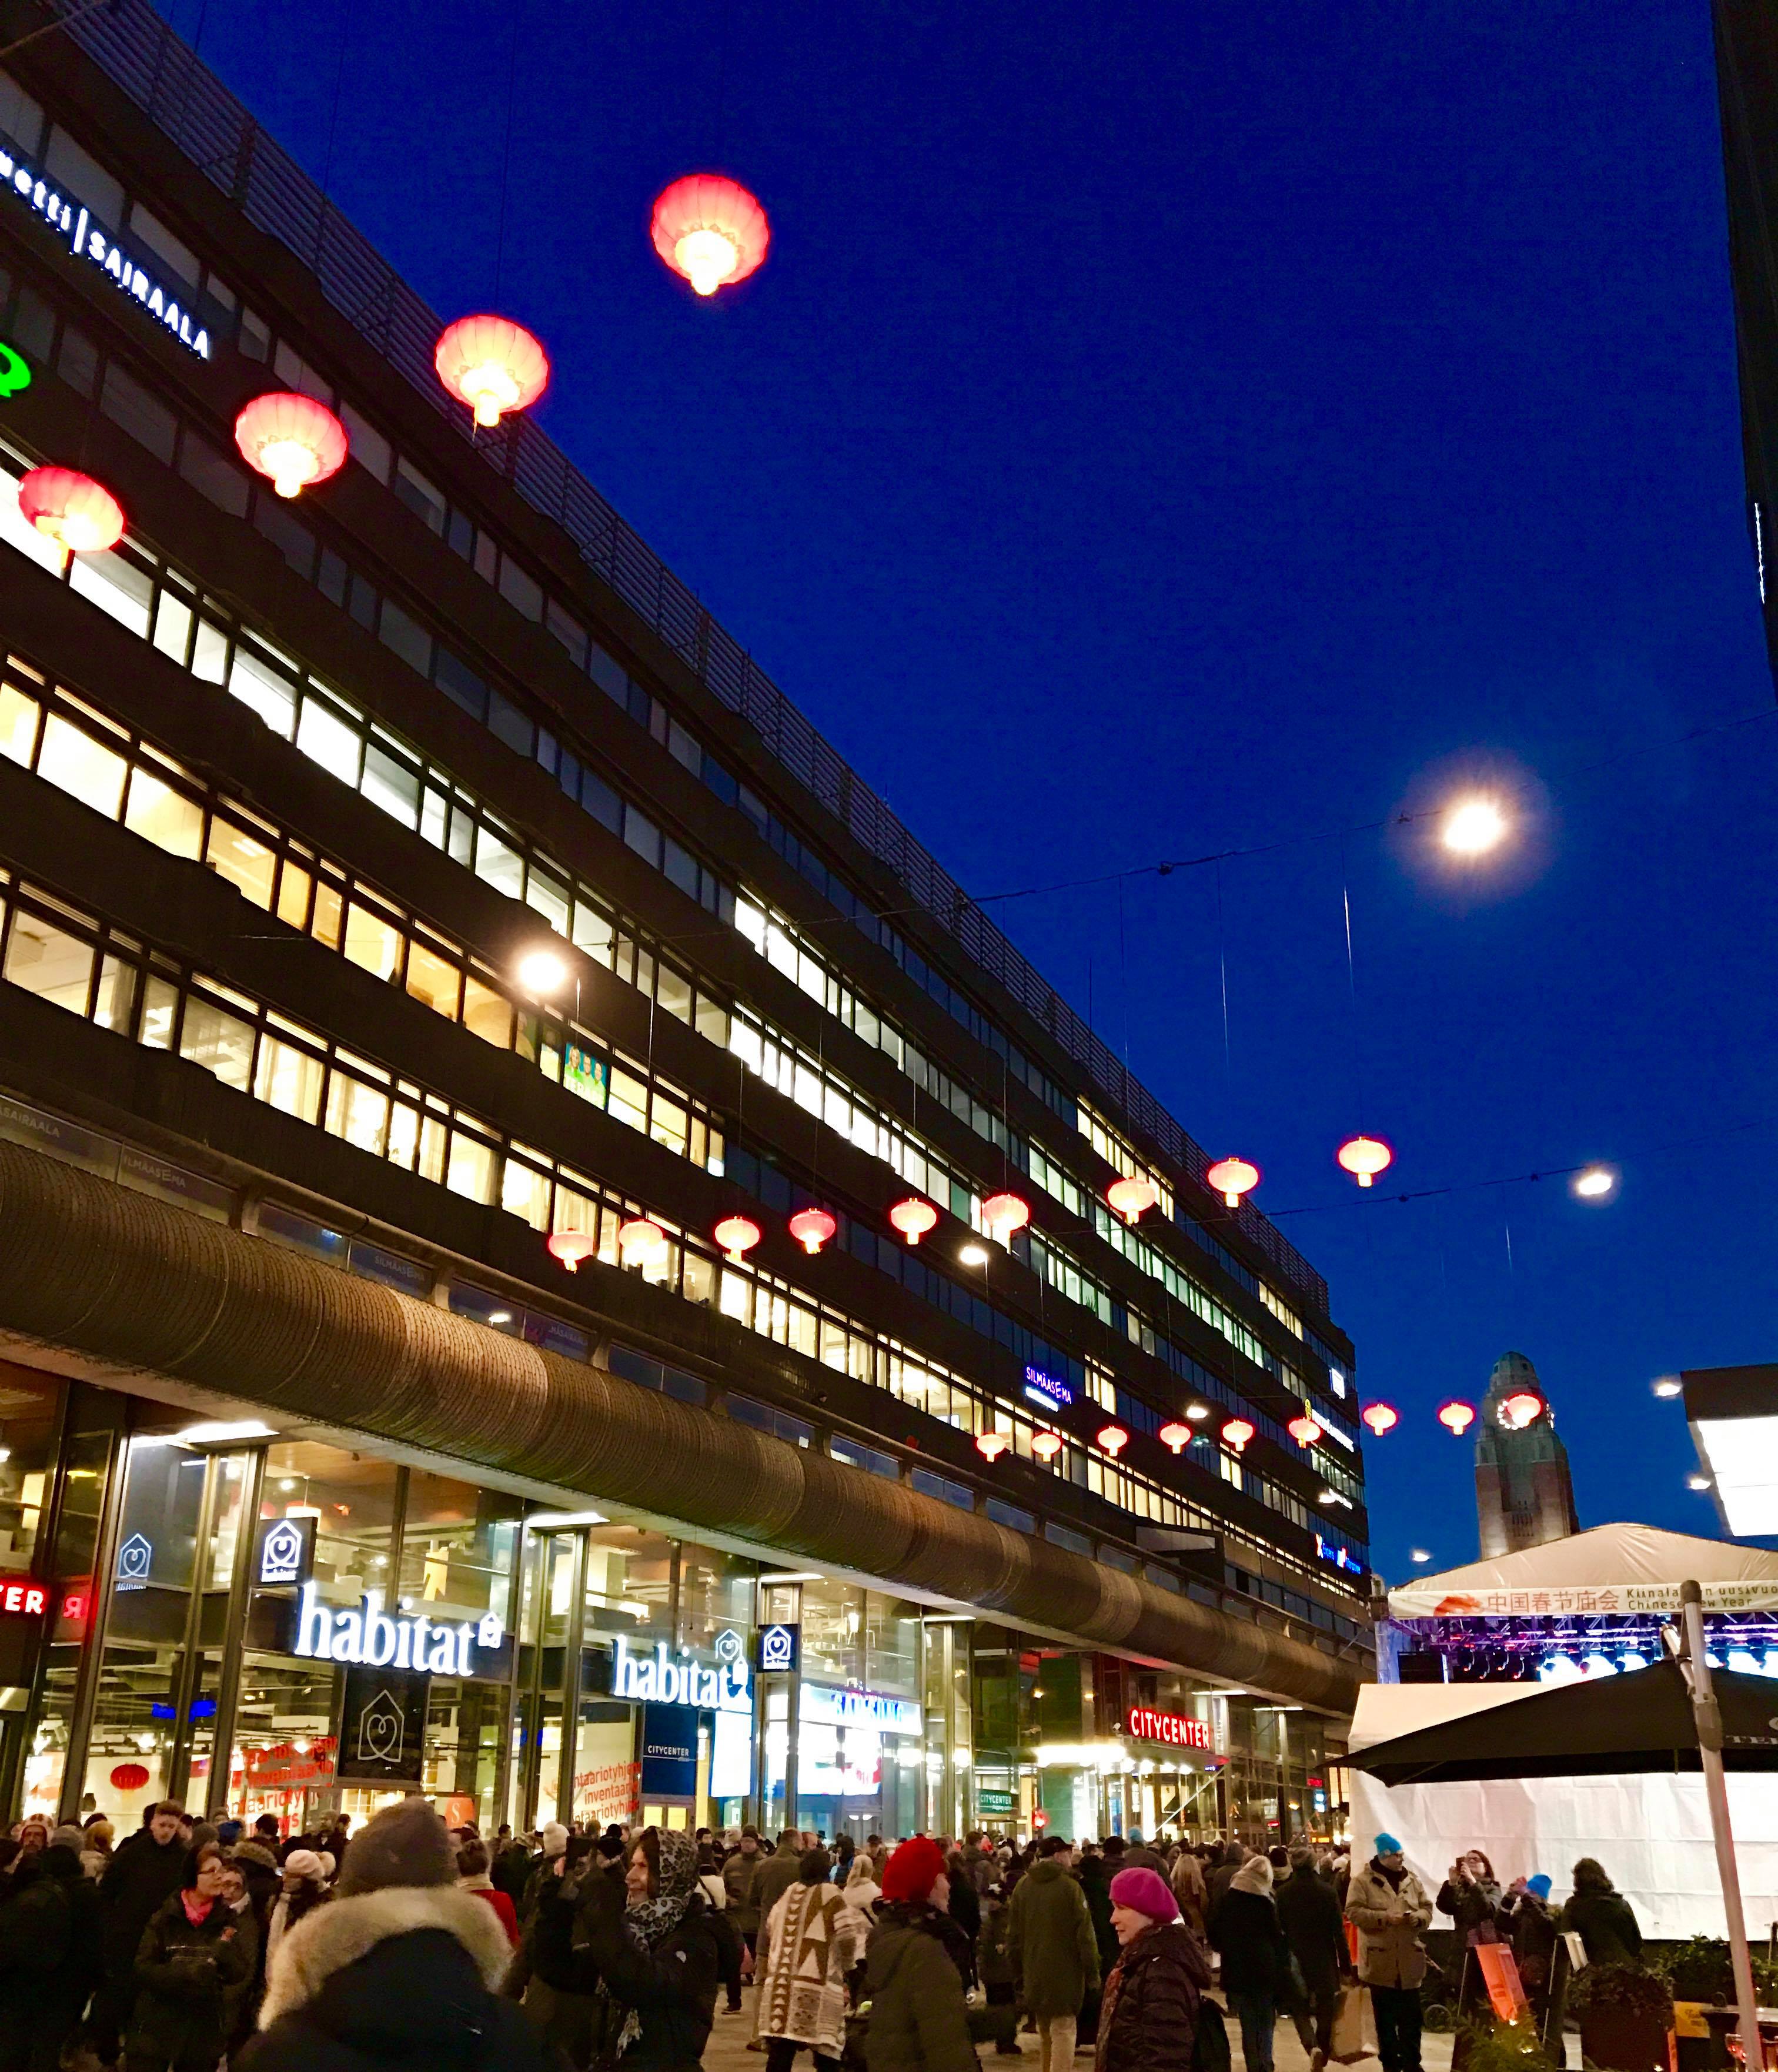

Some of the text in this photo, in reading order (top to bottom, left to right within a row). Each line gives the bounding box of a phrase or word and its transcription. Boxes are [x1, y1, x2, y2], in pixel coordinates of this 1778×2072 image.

[89, 231, 208, 359] SAIRAALA
[1026, 1366, 1072, 1405] SILMÄASEMA
[1488, 1589, 1619, 1613] 中国春节庙会
[1626, 1587, 1713, 1599] Kiinalan
[1628, 1599, 1685, 1610] Chinese
[1720, 1597, 1753, 1608] Year
[293, 1580, 476, 1677] habitat
[611, 1633, 731, 1709] habitat
[1131, 1709, 1210, 1750] CITYCENTER
[647, 1745, 690, 1757] CITYCENTER
[980, 1794, 1012, 1805] CITYCENTER
